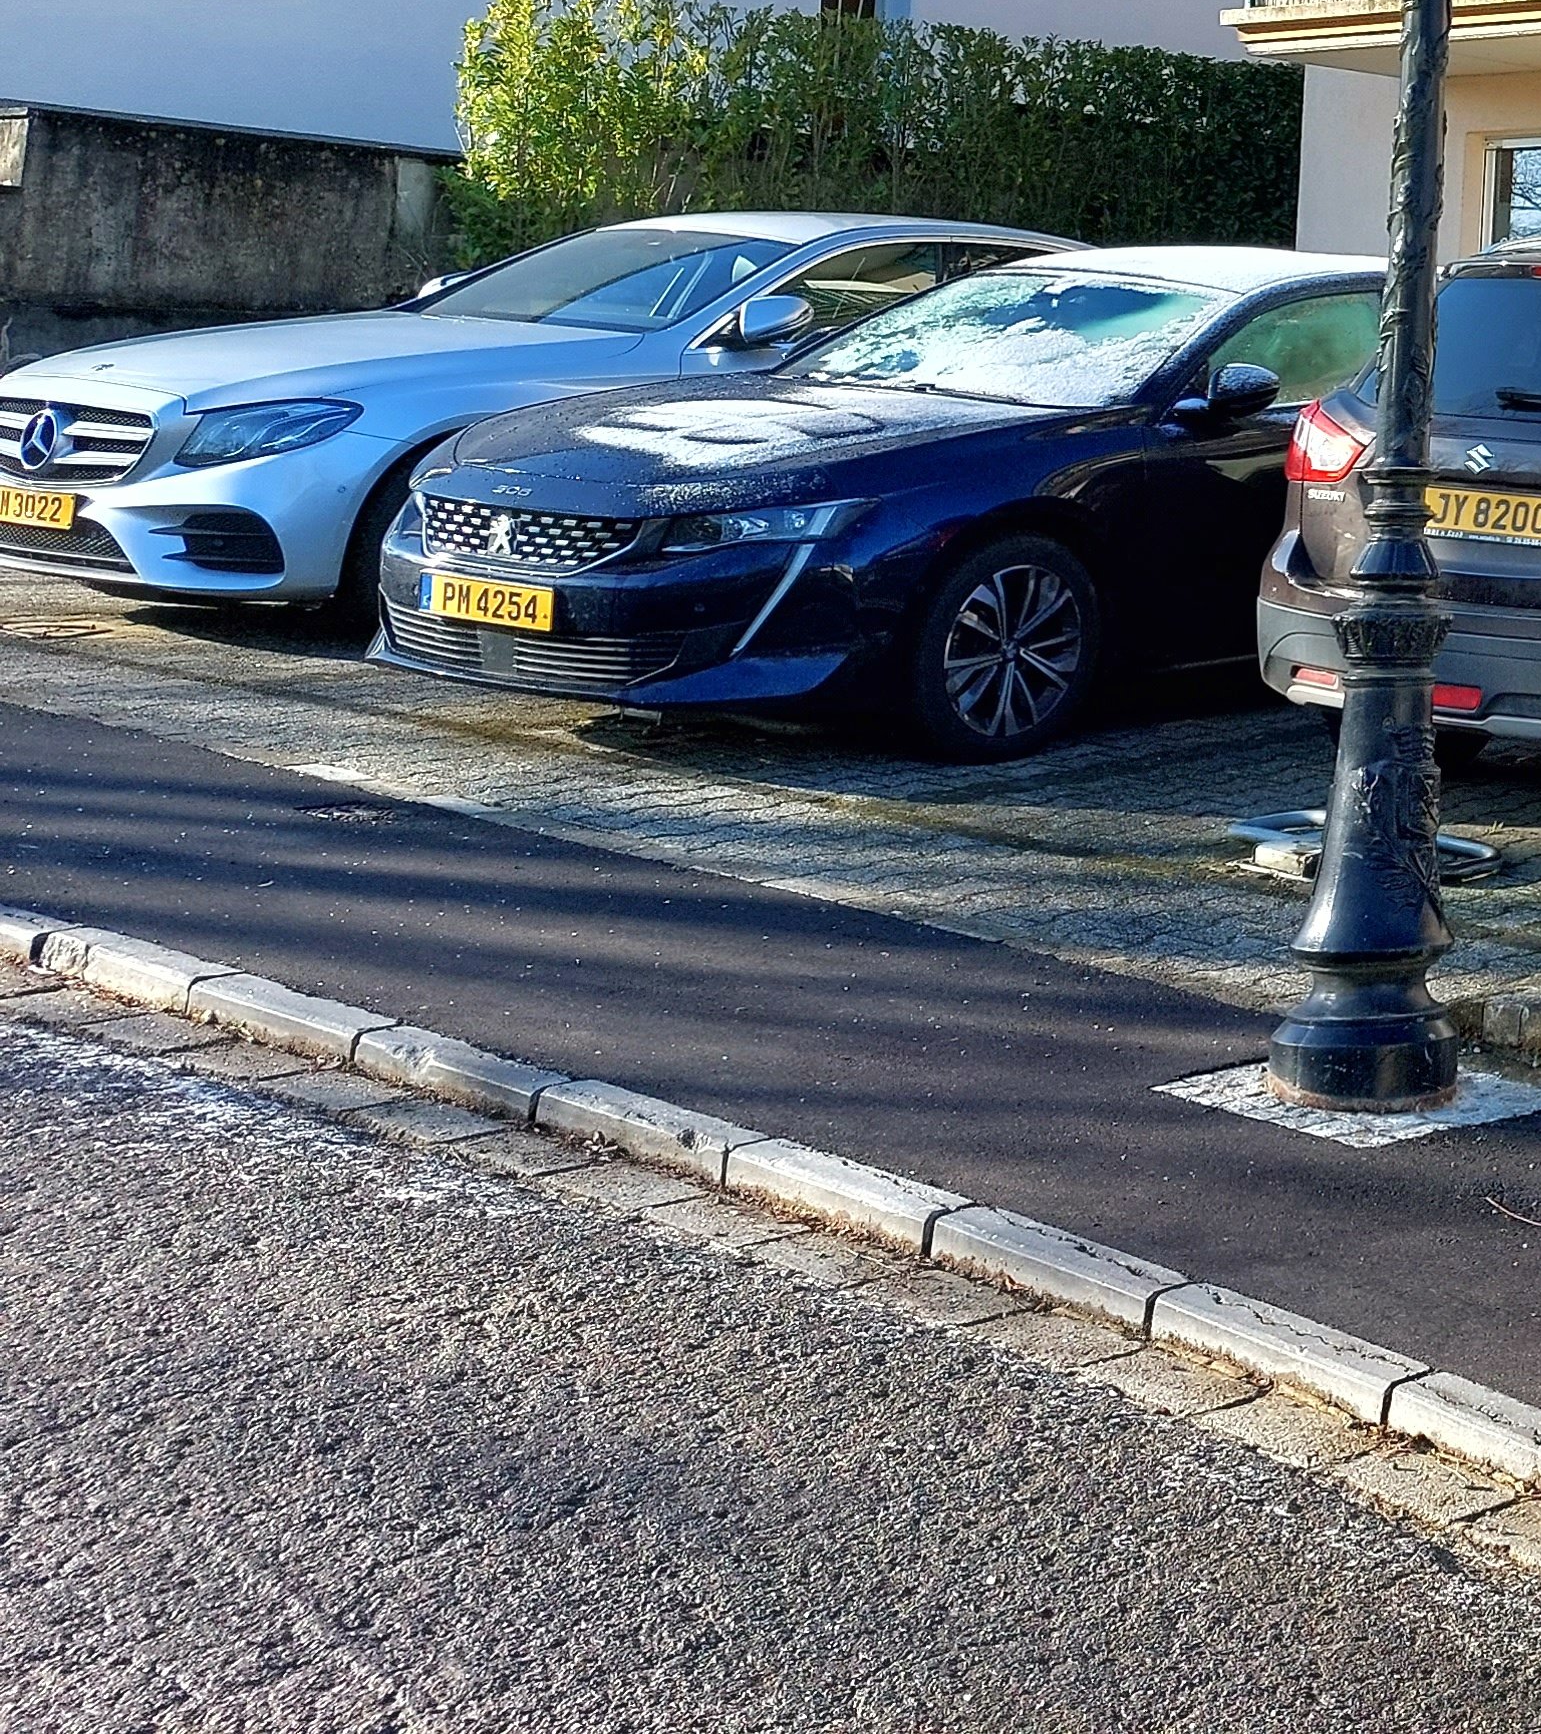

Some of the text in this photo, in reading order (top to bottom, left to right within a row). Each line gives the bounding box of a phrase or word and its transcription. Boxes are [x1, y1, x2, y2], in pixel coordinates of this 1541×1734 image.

[13, 492, 63, 523] 3022
[1308, 488, 1346, 503] SUZUKI
[1433, 493, 1469, 526] JY
[443, 582, 538, 624] PM 4254
